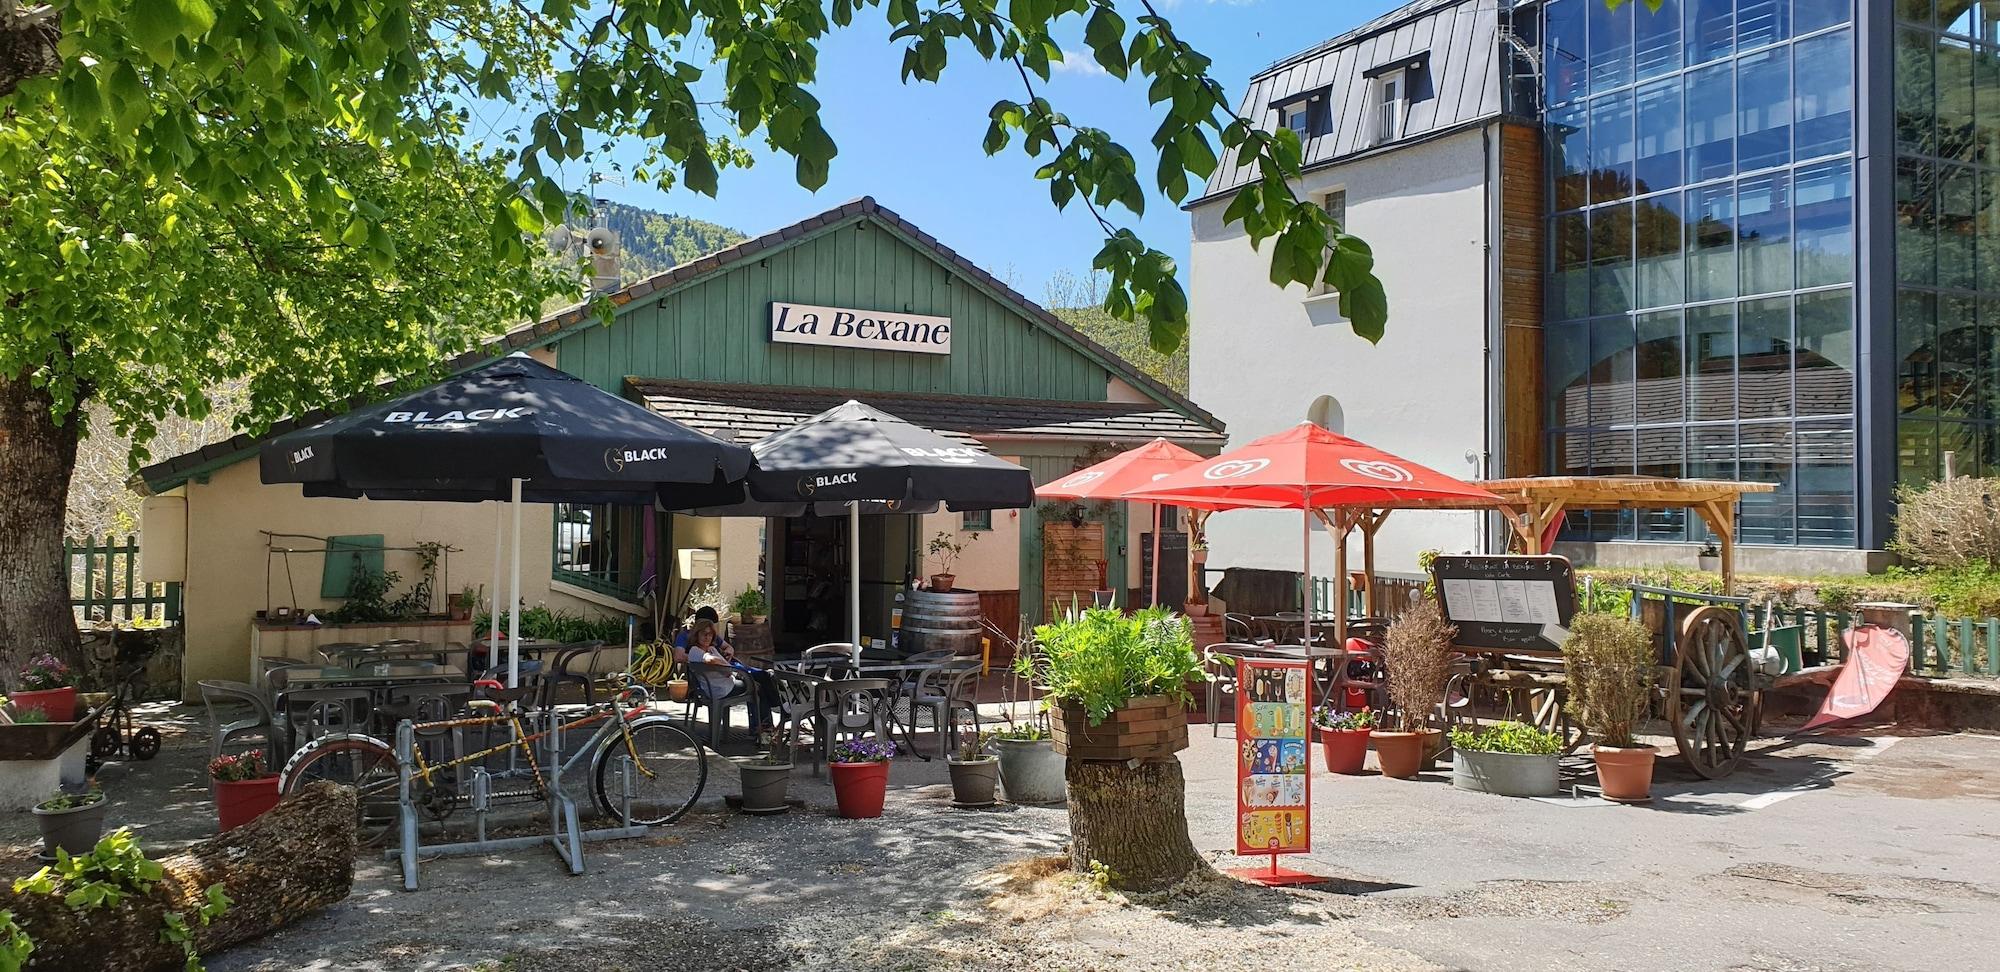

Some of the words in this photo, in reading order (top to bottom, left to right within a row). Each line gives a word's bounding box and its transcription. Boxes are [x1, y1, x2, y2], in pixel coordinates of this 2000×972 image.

[774, 306, 820, 335] La
[829, 311, 951, 345] Bexane
[383, 406, 526, 423] BLACK
[293, 445, 315, 464] BLACK
[623, 447, 668, 463] BLACK
[900, 447, 985, 457] BLACK
[816, 472, 858, 487] BLACK
